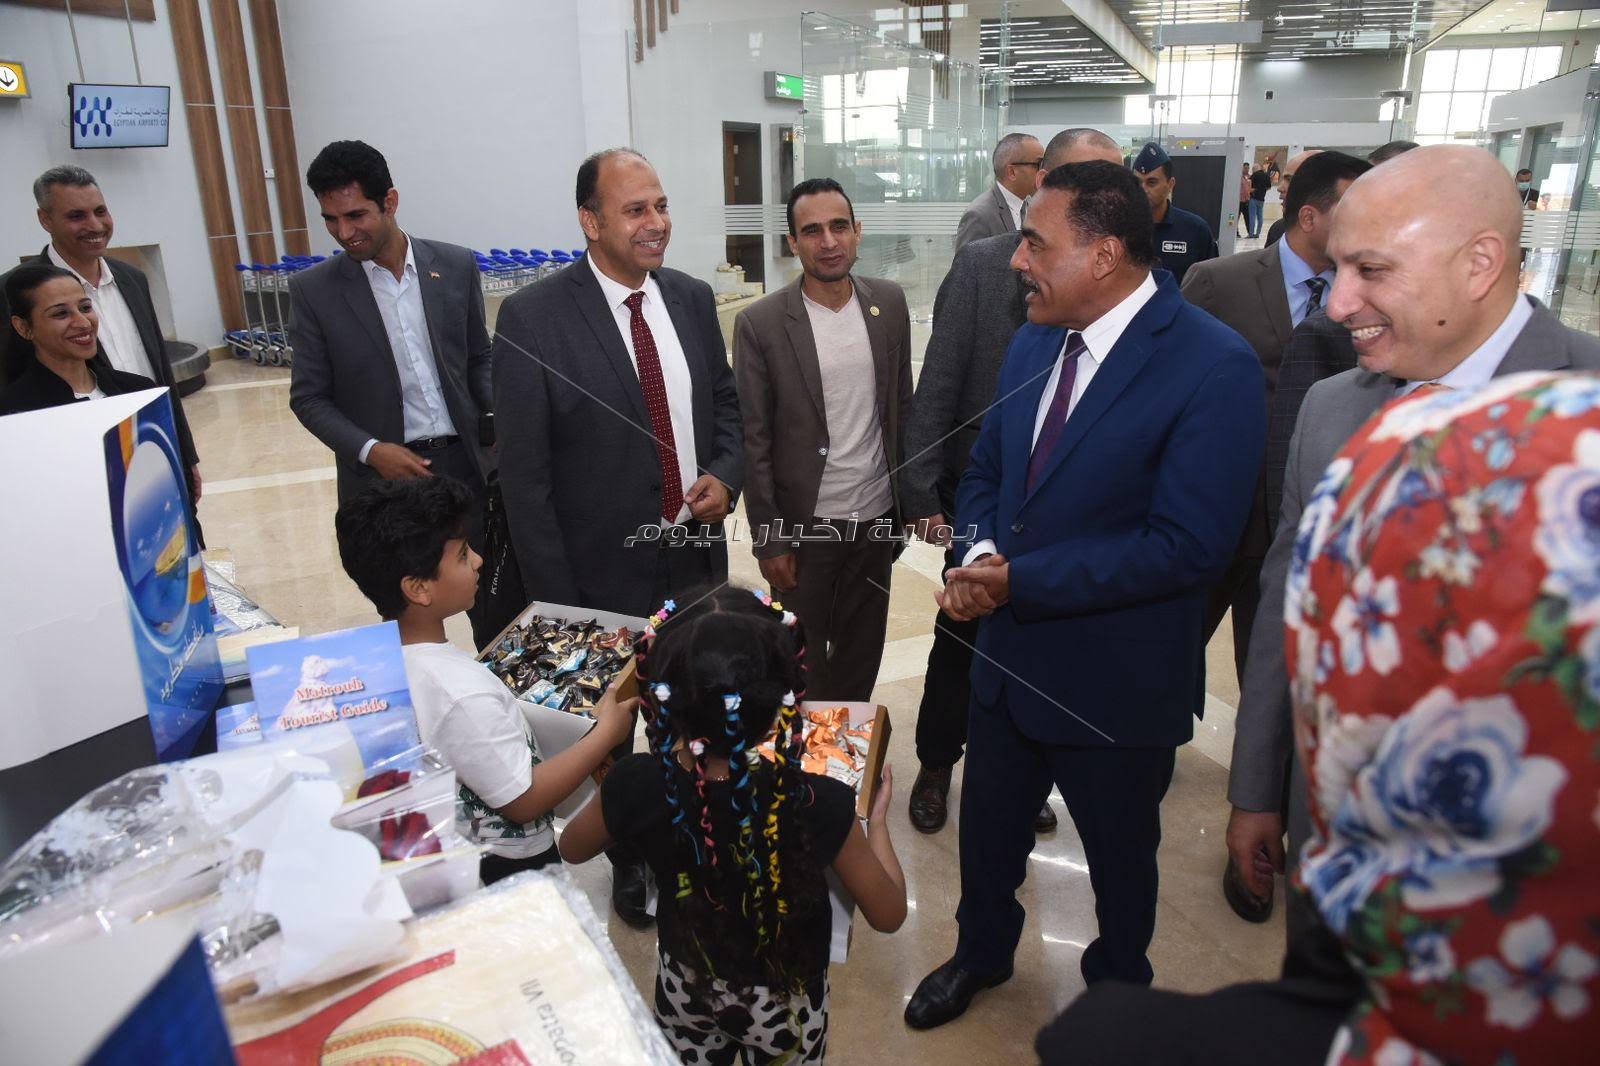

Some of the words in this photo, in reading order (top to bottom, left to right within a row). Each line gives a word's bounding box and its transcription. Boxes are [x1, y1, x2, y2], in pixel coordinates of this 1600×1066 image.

[296, 677, 365, 700] Matrouh
[280, 709, 339, 730] Tourist
[341, 697, 388, 718] Guide
